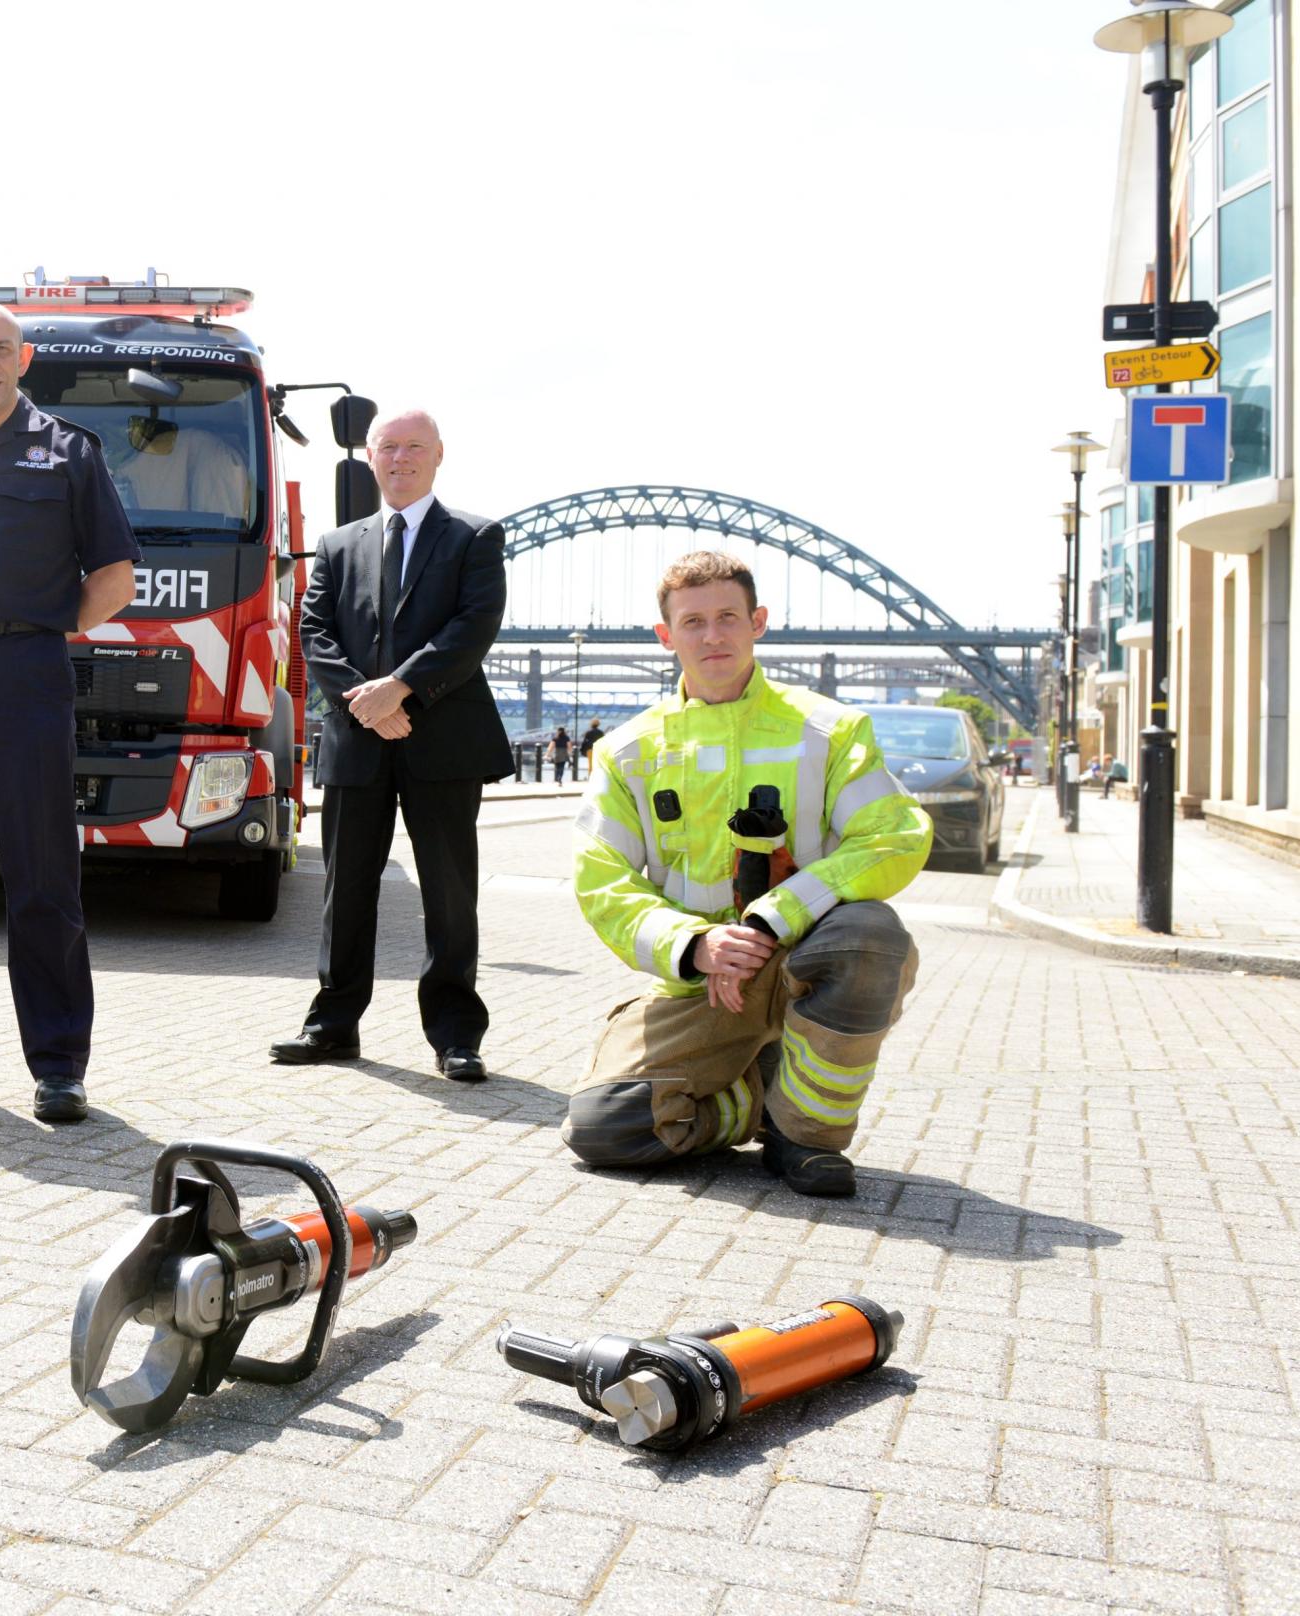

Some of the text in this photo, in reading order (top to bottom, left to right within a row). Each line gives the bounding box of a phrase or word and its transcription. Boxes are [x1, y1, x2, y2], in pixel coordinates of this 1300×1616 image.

[25, 288, 77, 298] FIRE
[32, 343, 103, 354] ECTING
[114, 345, 236, 363] RESPONDING
[1111, 350, 1193, 366] Event Detour
[1114, 370, 1129, 381] 72
[161, 649, 183, 660] FL
[237, 1273, 275, 1298] holmatro
